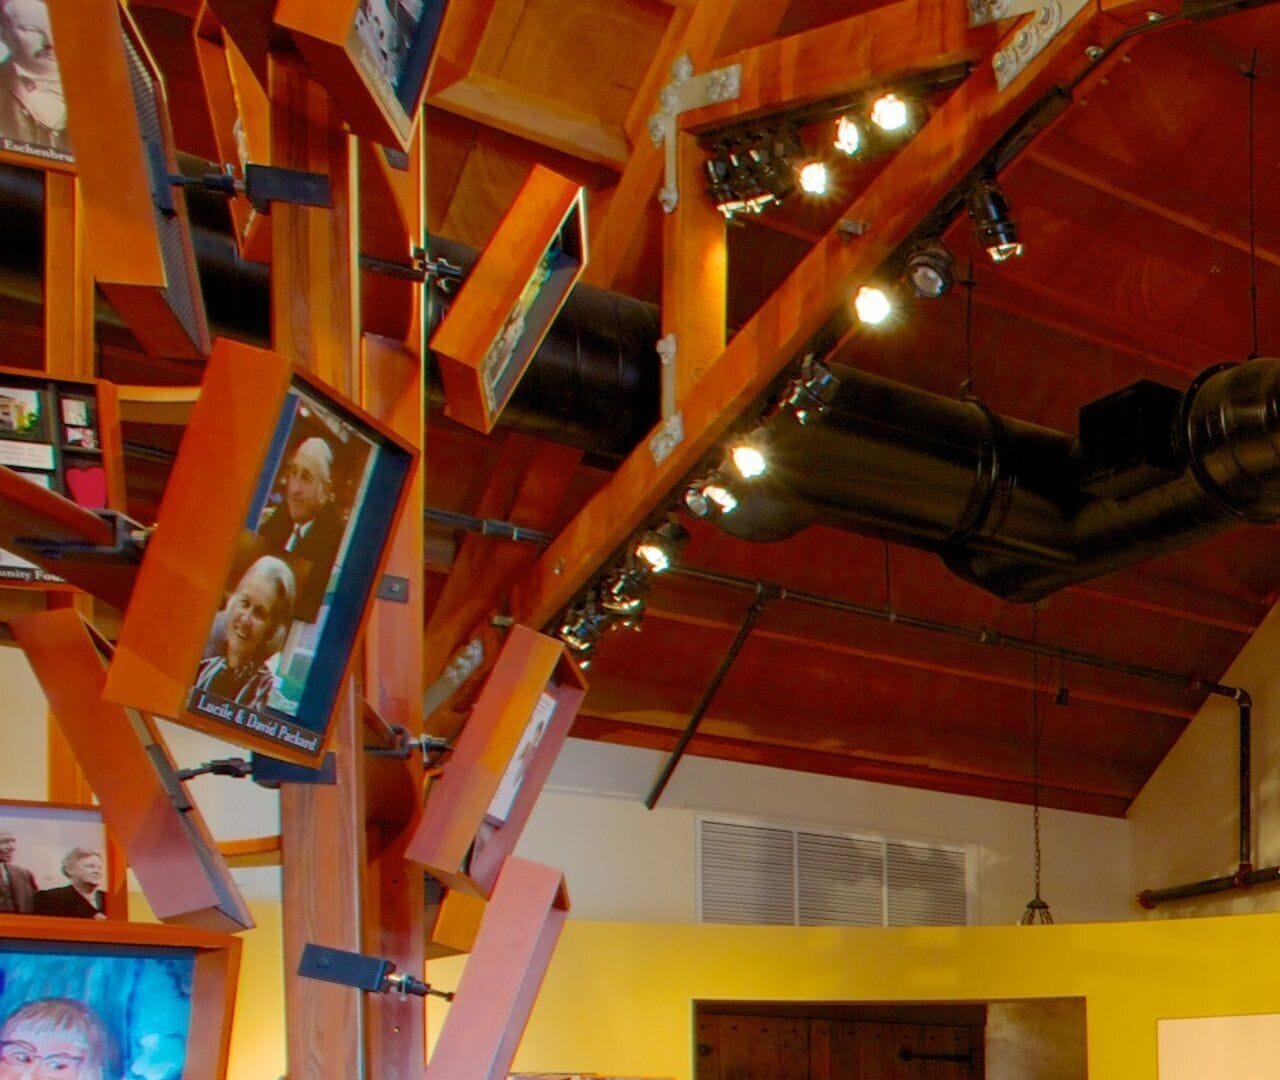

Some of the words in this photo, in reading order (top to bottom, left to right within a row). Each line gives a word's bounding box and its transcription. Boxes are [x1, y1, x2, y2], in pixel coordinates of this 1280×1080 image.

[197, 695, 233, 720] Lucile
[234, 708, 245, 725] &
[246, 713, 278, 737] David
[278, 725, 318, 752] Packard
